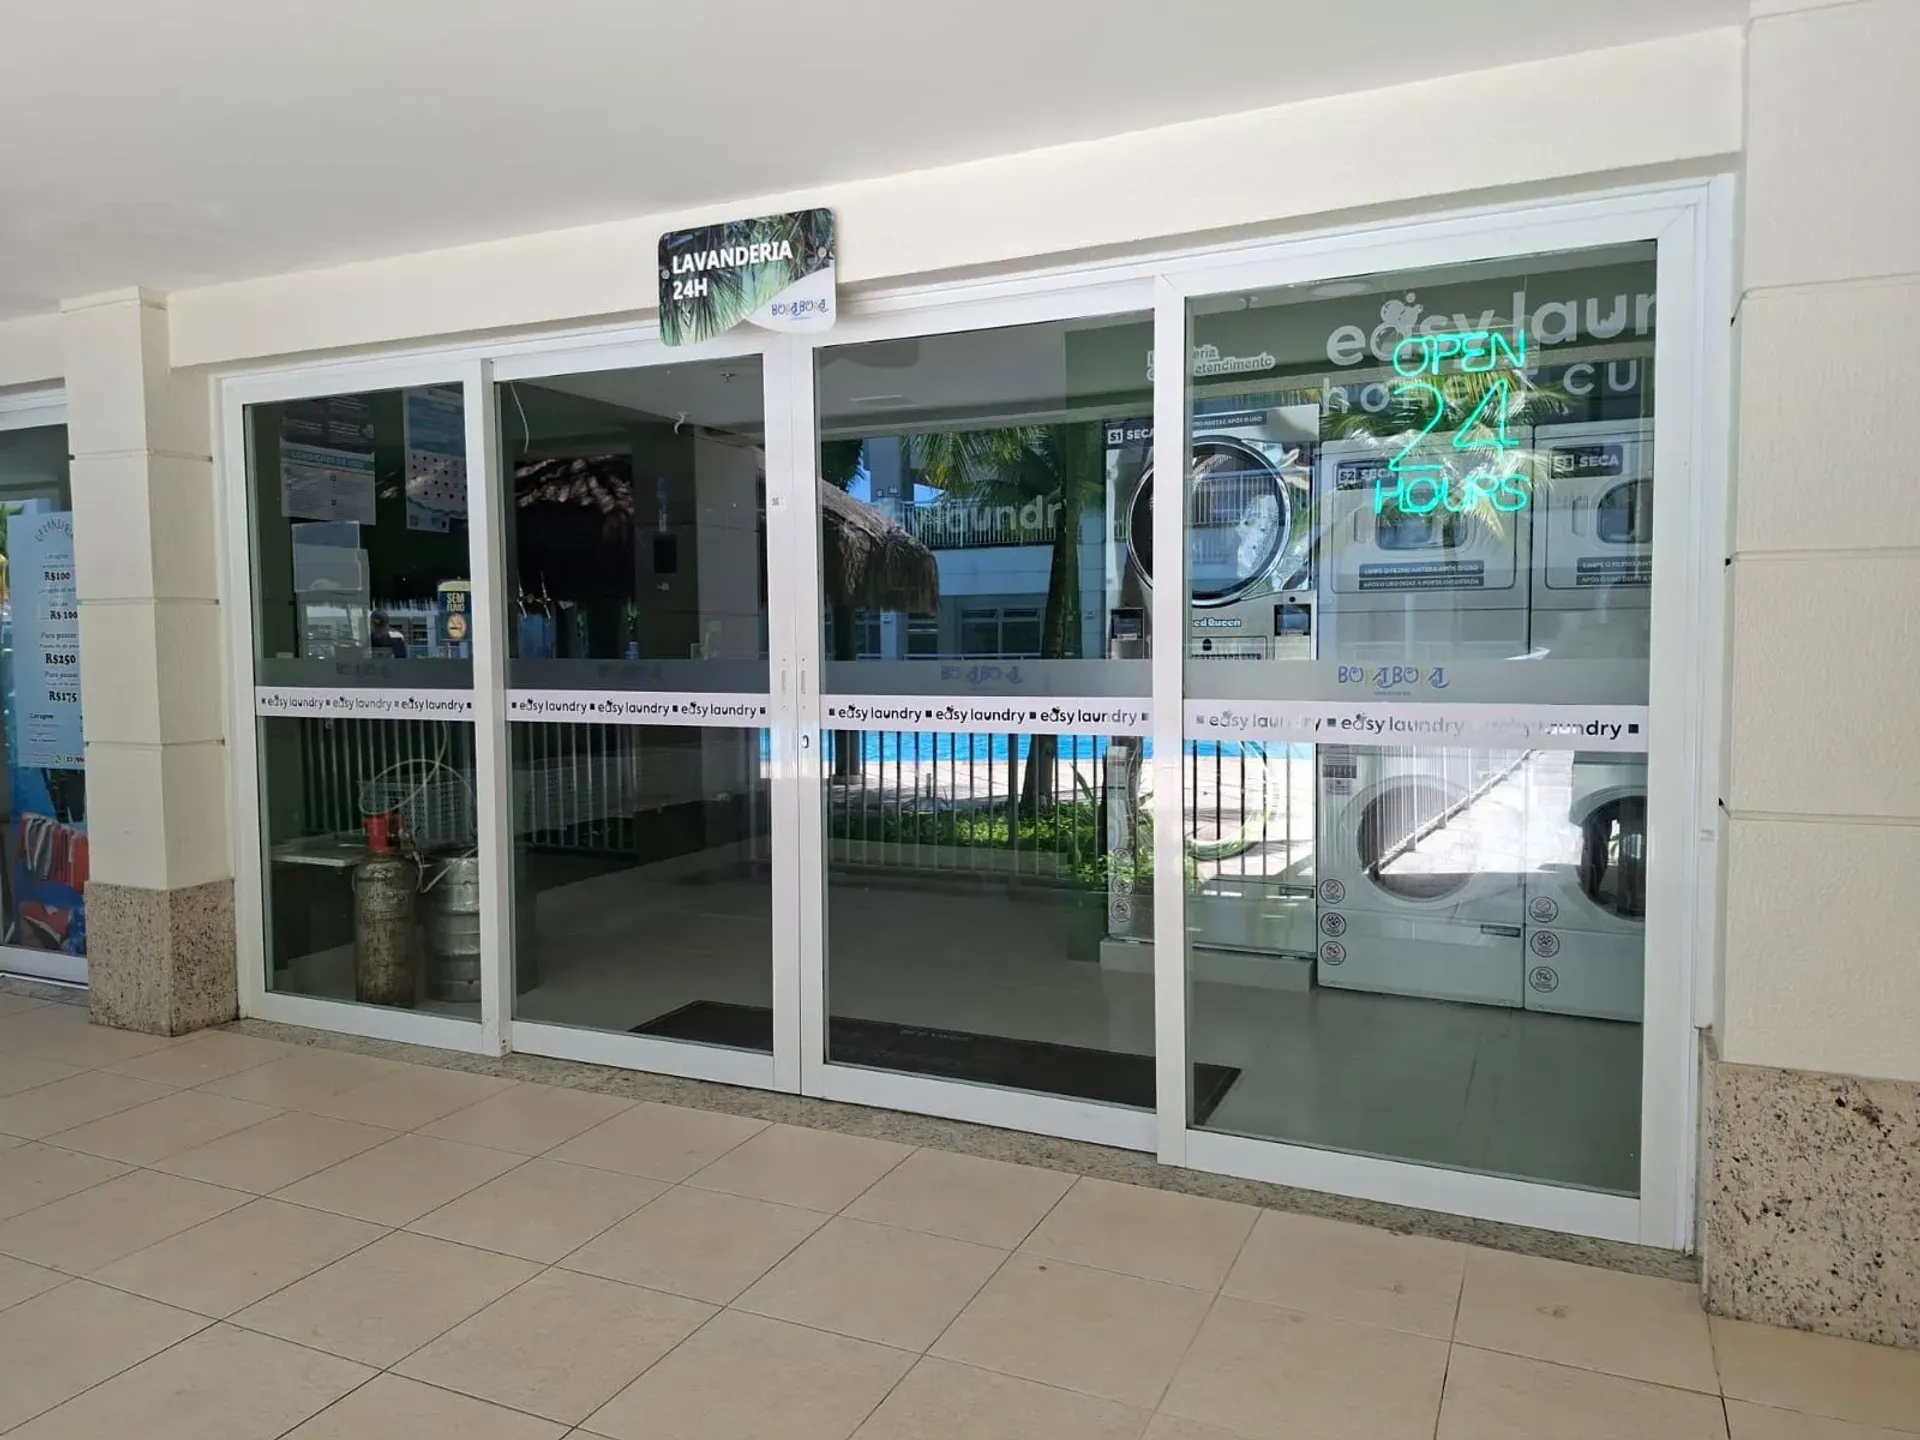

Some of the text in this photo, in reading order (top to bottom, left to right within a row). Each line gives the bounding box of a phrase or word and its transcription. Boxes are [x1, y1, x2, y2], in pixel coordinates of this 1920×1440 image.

[673, 240, 793, 274] LAVANDERIA
[672, 278, 707, 300] 24H
[1393, 329, 1526, 377] OPEN
[1388, 377, 1519, 472] 24
[1110, 430, 1121, 442] S1
[1579, 454, 1619, 468] SECA
[1340, 470, 1355, 481] S2
[1373, 471, 1532, 517] HOURS
[44, 571, 71, 581] R$100
[447, 592, 465, 604] SEM
[50, 610, 78, 620] R$ 100
[45, 652, 76, 665] R$250
[49, 690, 77, 703] R$175
[267, 695, 324, 711] easy laundry
[332, 696, 392, 713] easy laundry
[401, 697, 465, 713] easy laundry
[519, 699, 587, 716] easy laundry
[597, 700, 669, 718] easy laundry
[681, 701, 757, 720] easy laundry
[838, 704, 922, 724] easy laundry
[935, 705, 1025, 726] easy laundry
[1040, 706, 1075, 726] easy
[1209, 711, 1249, 731] easy
[1341, 712, 1385, 735] easy
